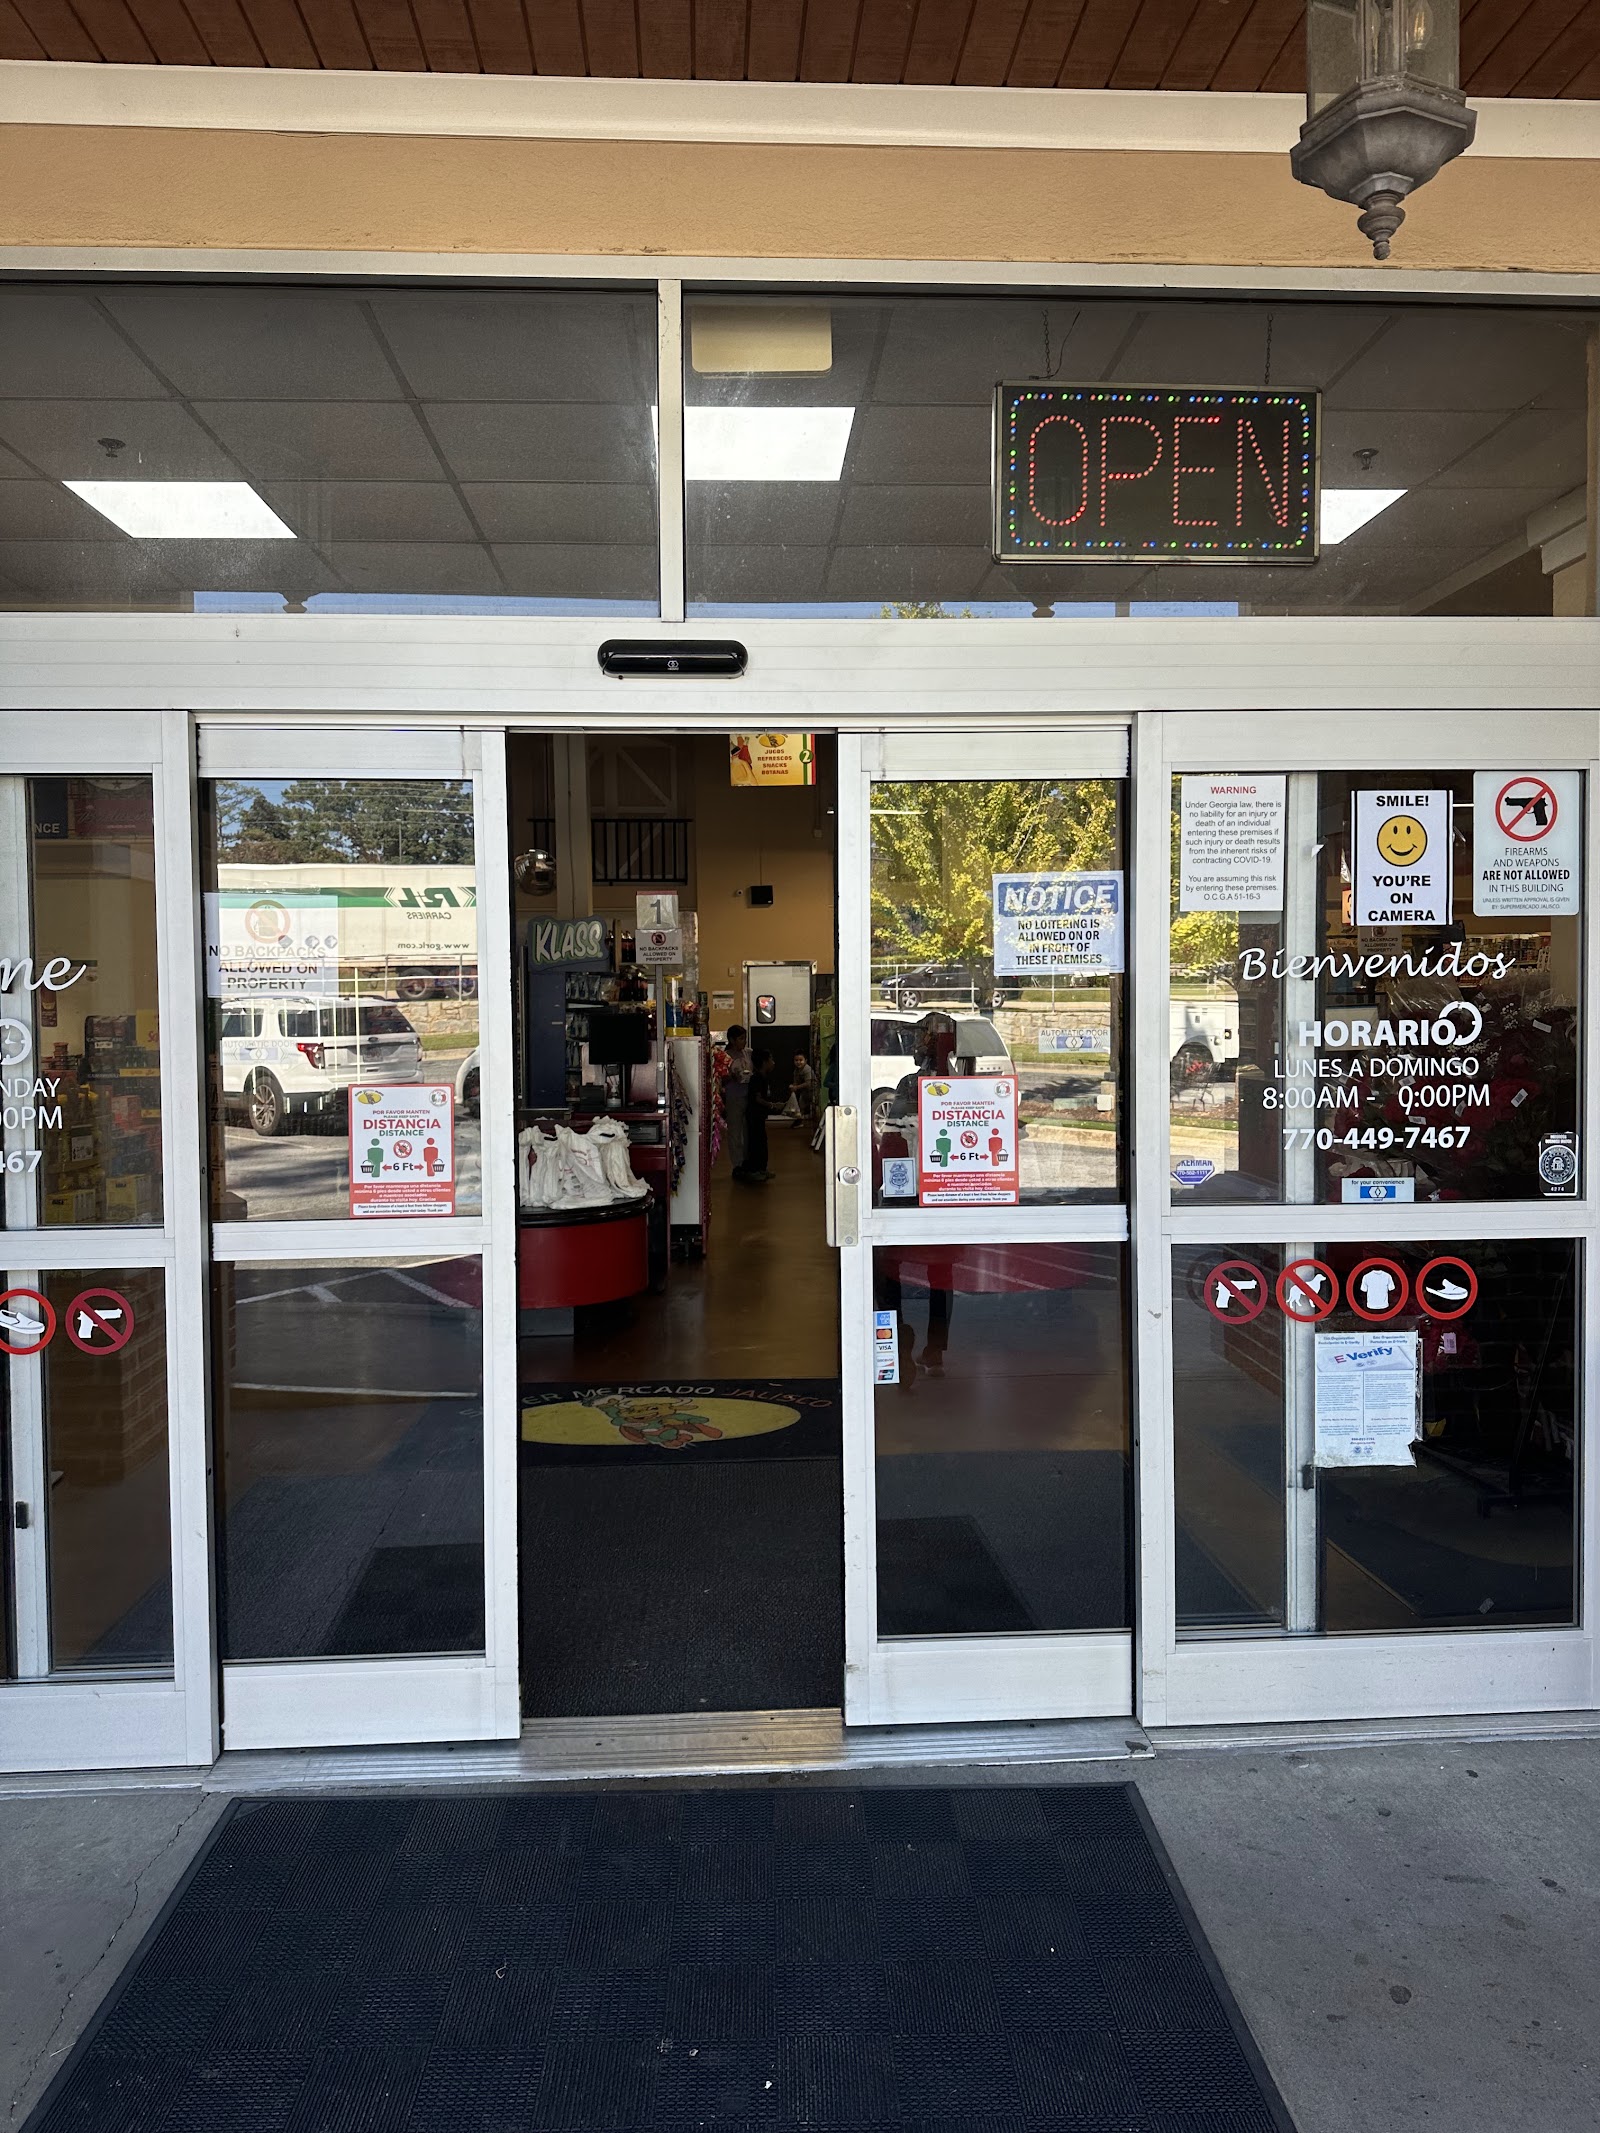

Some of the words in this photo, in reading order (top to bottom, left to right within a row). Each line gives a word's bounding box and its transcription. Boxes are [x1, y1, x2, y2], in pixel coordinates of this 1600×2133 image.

[1029, 415, 1289, 527] OPEN
[802, 751, 810, 762] 2
[1211, 786, 1256, 794] WARNING
[1376, 795, 1429, 806] SMILE!
[1240, 829, 1272, 837] premises
[1193, 857, 1231, 865] contracting
[1234, 856, 1272, 864] COVID-19.
[1493, 859, 1513, 867] AND
[1516, 859, 1560, 867] WEAPONS
[1483, 871, 1500, 880] ARE
[1504, 870, 1522, 880] NOT
[1525, 870, 1570, 880] ALLOWED
[1373, 876, 1431, 886] YOU'RE
[1246, 884, 1278, 892] premises.
[1489, 884, 1498, 892] IN
[1501, 884, 1519, 892] THIS
[1522, 884, 1564, 892] BUILDING
[1004, 885, 1114, 911] NOTICE
[1390, 893, 1413, 904] ON
[650, 900, 661, 924] 1
[1368, 910, 1435, 921] CAMERA
[1018, 920, 1032, 929] NO
[1035, 920, 1087, 929] LOITERING
[1091, 919, 1100, 928] IS
[536, 922, 600, 961] KLASS
[1019, 932, 1065, 941] ALLOWED
[1069, 931, 1082, 940] ON
[1086, 931, 1099, 940] OR
[209, 946, 230, 957] NO
[235, 946, 326, 957] BACKPACKS
[1030, 945, 1039, 953] IN
[1043, 944, 1073, 952] FRONT
[1077, 943, 1090, 952] OF
[1016, 956, 1047, 965] THESE
[1050, 954, 1102, 964] PREMISES
[1239, 942, 1516, 981] Bienvenidos
[219, 962, 291, 973] ALLOWED
[297, 963, 317, 974] ON
[228, 978, 307, 989] PROPERTY
[1300, 1020, 1457, 1046] HORARIO
[1275, 1059, 1342, 1078] LUNES
[1349, 1059, 1364, 1077] A
[1370, 1057, 1479, 1077] DOMINGO
[1263, 1086, 1359, 1109] 8:00AM
[932, 1110, 1005, 1120] DISTANCIA
[363, 1119, 441, 1129] DISTANCIA
[1282, 1126, 1470, 1150] 770-449-7467
[573, 1386, 715, 1398] MERCADO
[722, 1390, 833, 1409] JALISCO
